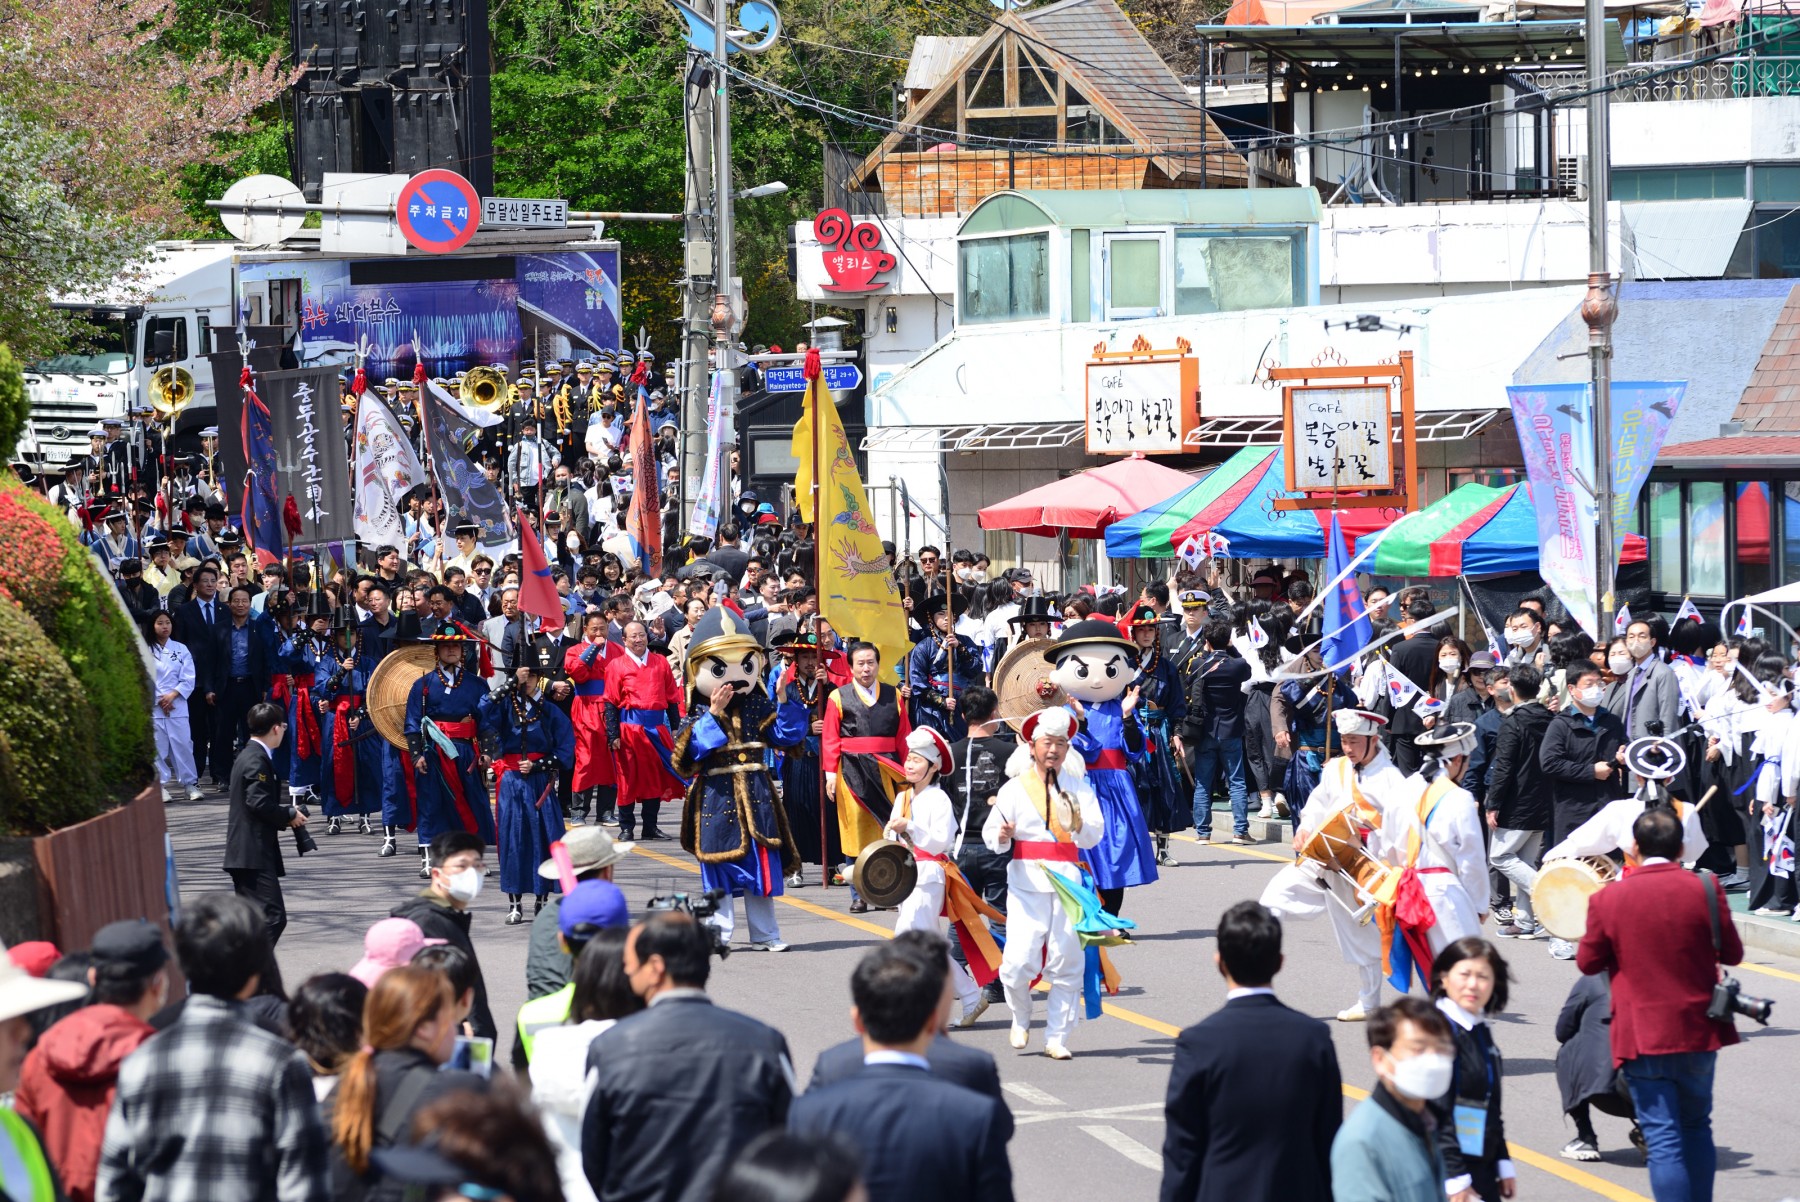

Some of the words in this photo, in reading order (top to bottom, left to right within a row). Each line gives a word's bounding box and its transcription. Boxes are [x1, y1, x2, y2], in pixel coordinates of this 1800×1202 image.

[486, 202, 563, 223] 유달산일주도로
[832, 254, 873, 273] 앨리스
[300, 298, 329, 330] 추는
[335, 297, 401, 324] 바다분수
[1095, 397, 1135, 444] 복숭아꽃
[1141, 397, 1177, 442] 살구꽃
[1305, 420, 1380, 449] 복숭아꽃
[1308, 454, 1375, 480] 살구꽃
